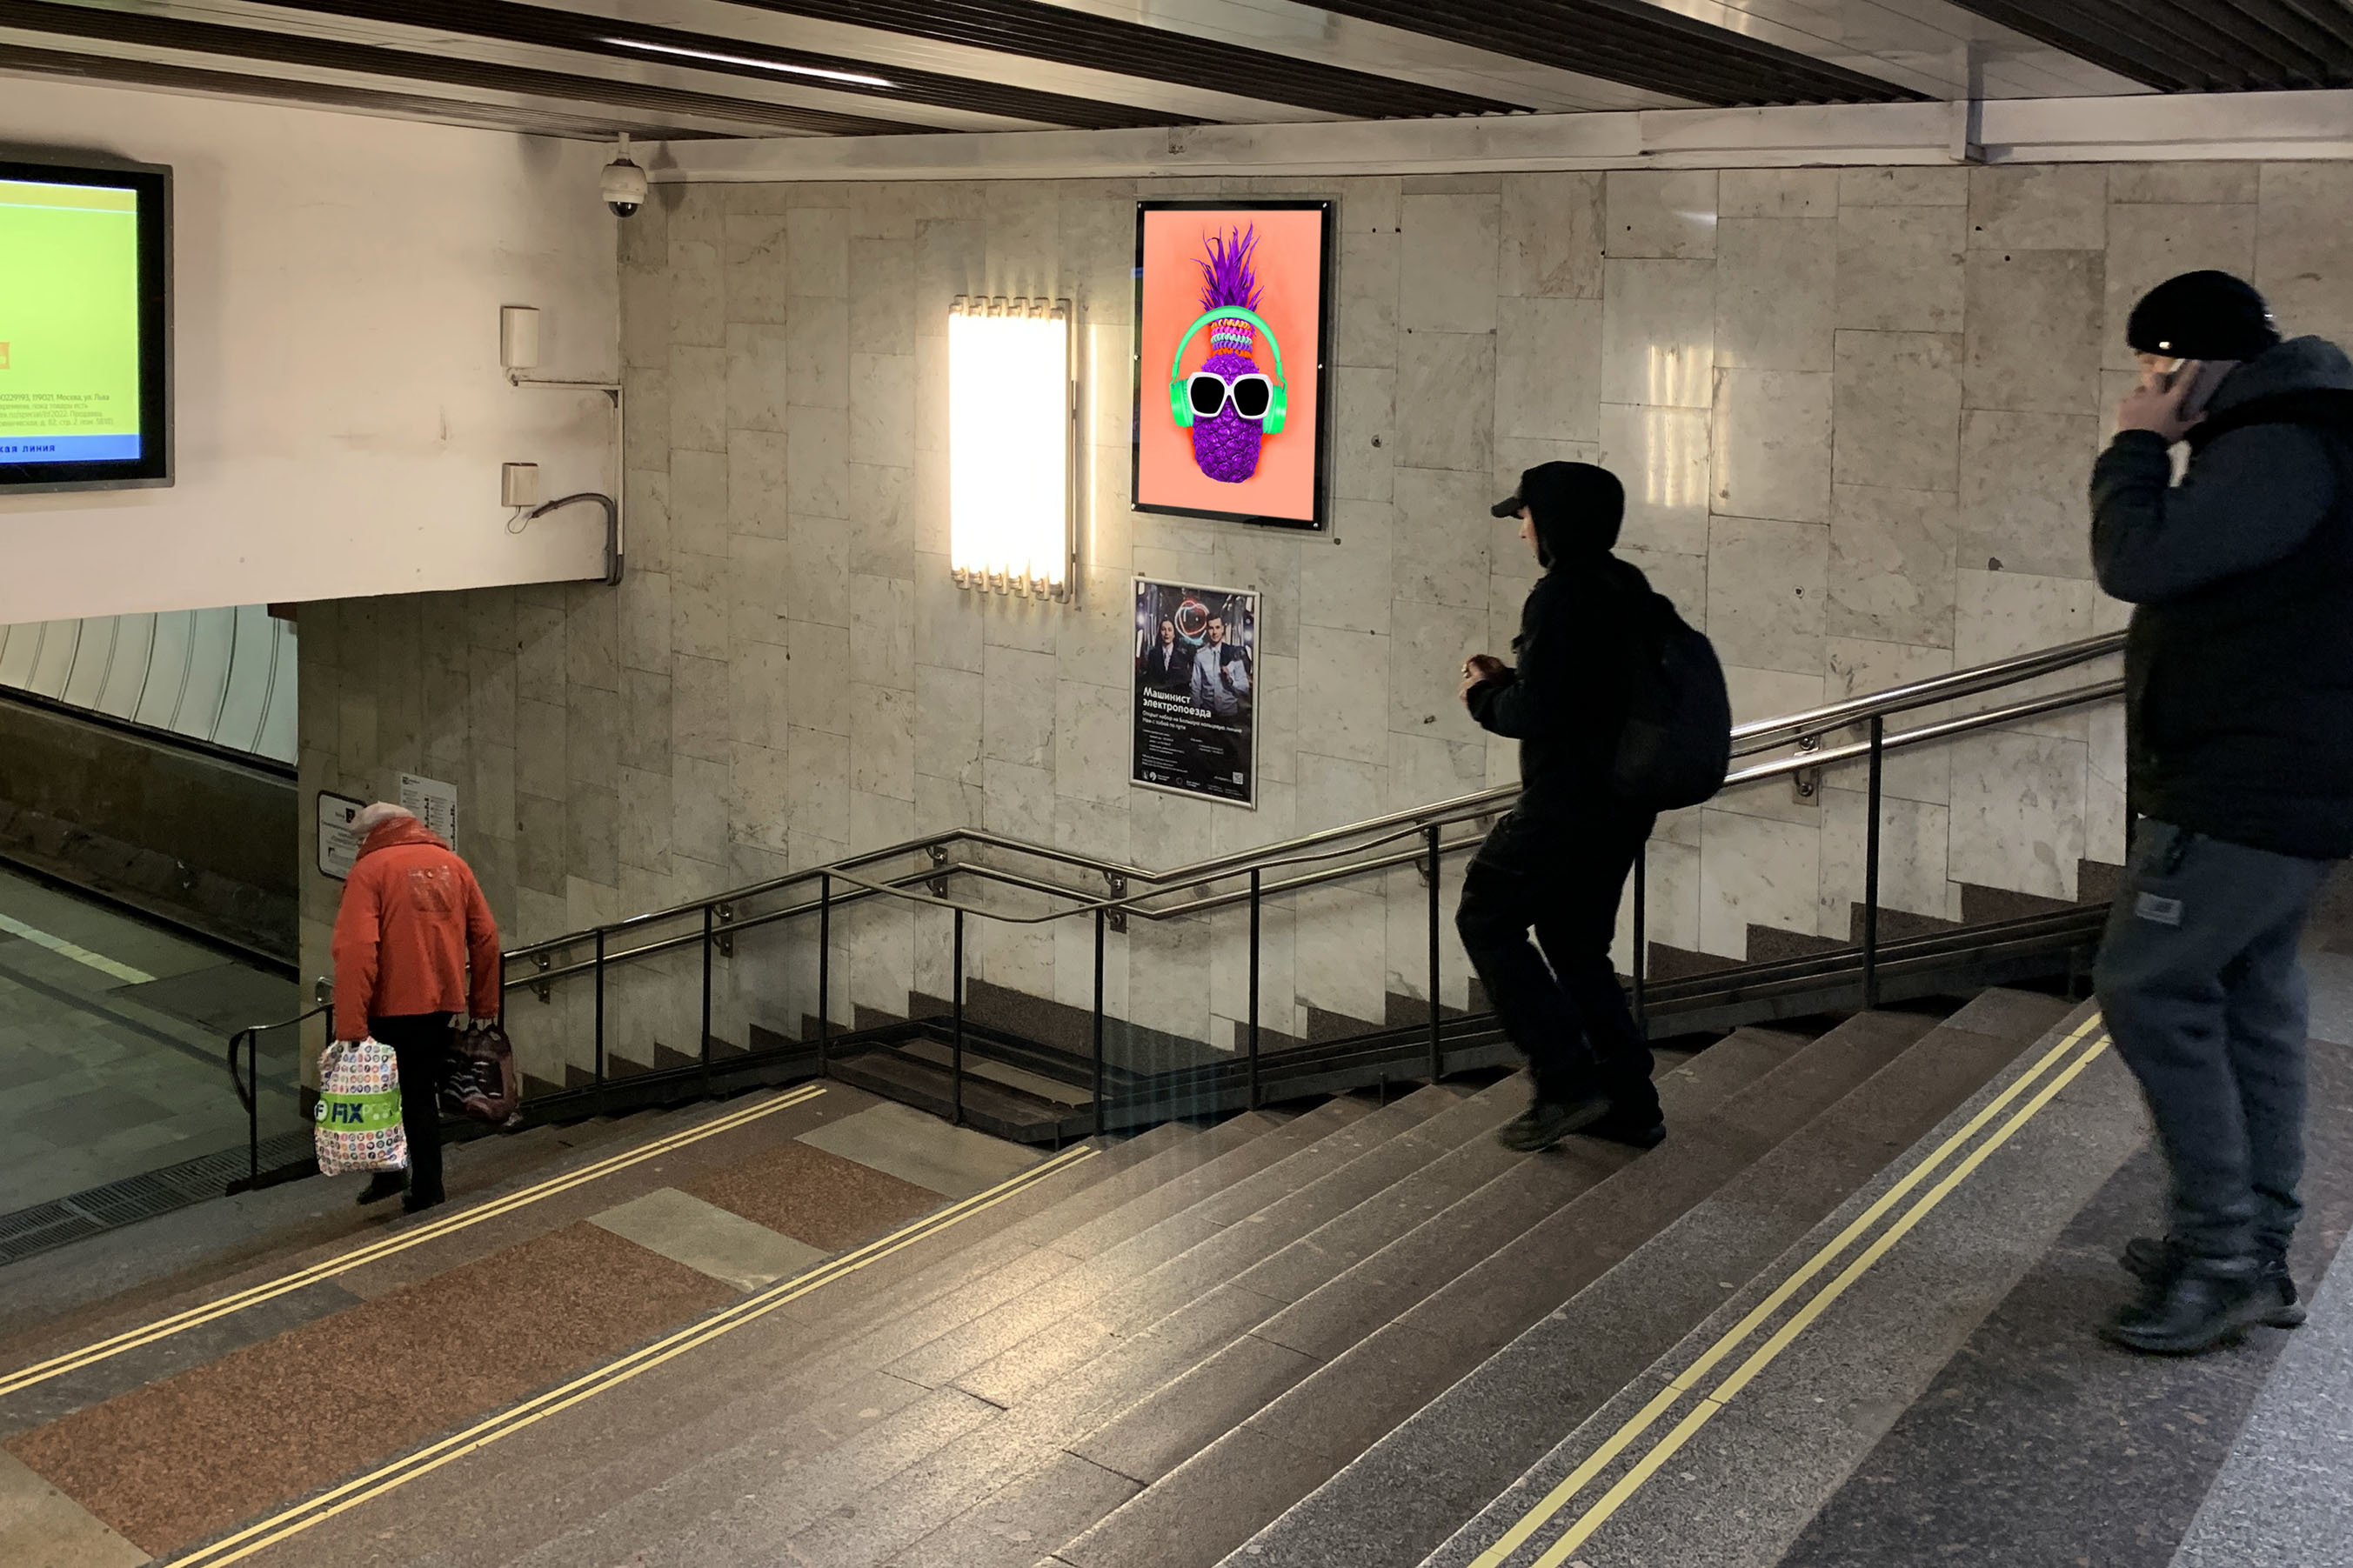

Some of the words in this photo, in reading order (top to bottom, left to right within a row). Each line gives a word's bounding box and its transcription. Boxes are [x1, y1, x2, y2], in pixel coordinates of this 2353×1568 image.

[1143, 686, 1191, 704] Машинист
[1143, 698, 1212, 718] электропоезда
[331, 1102, 364, 1124] FIX
